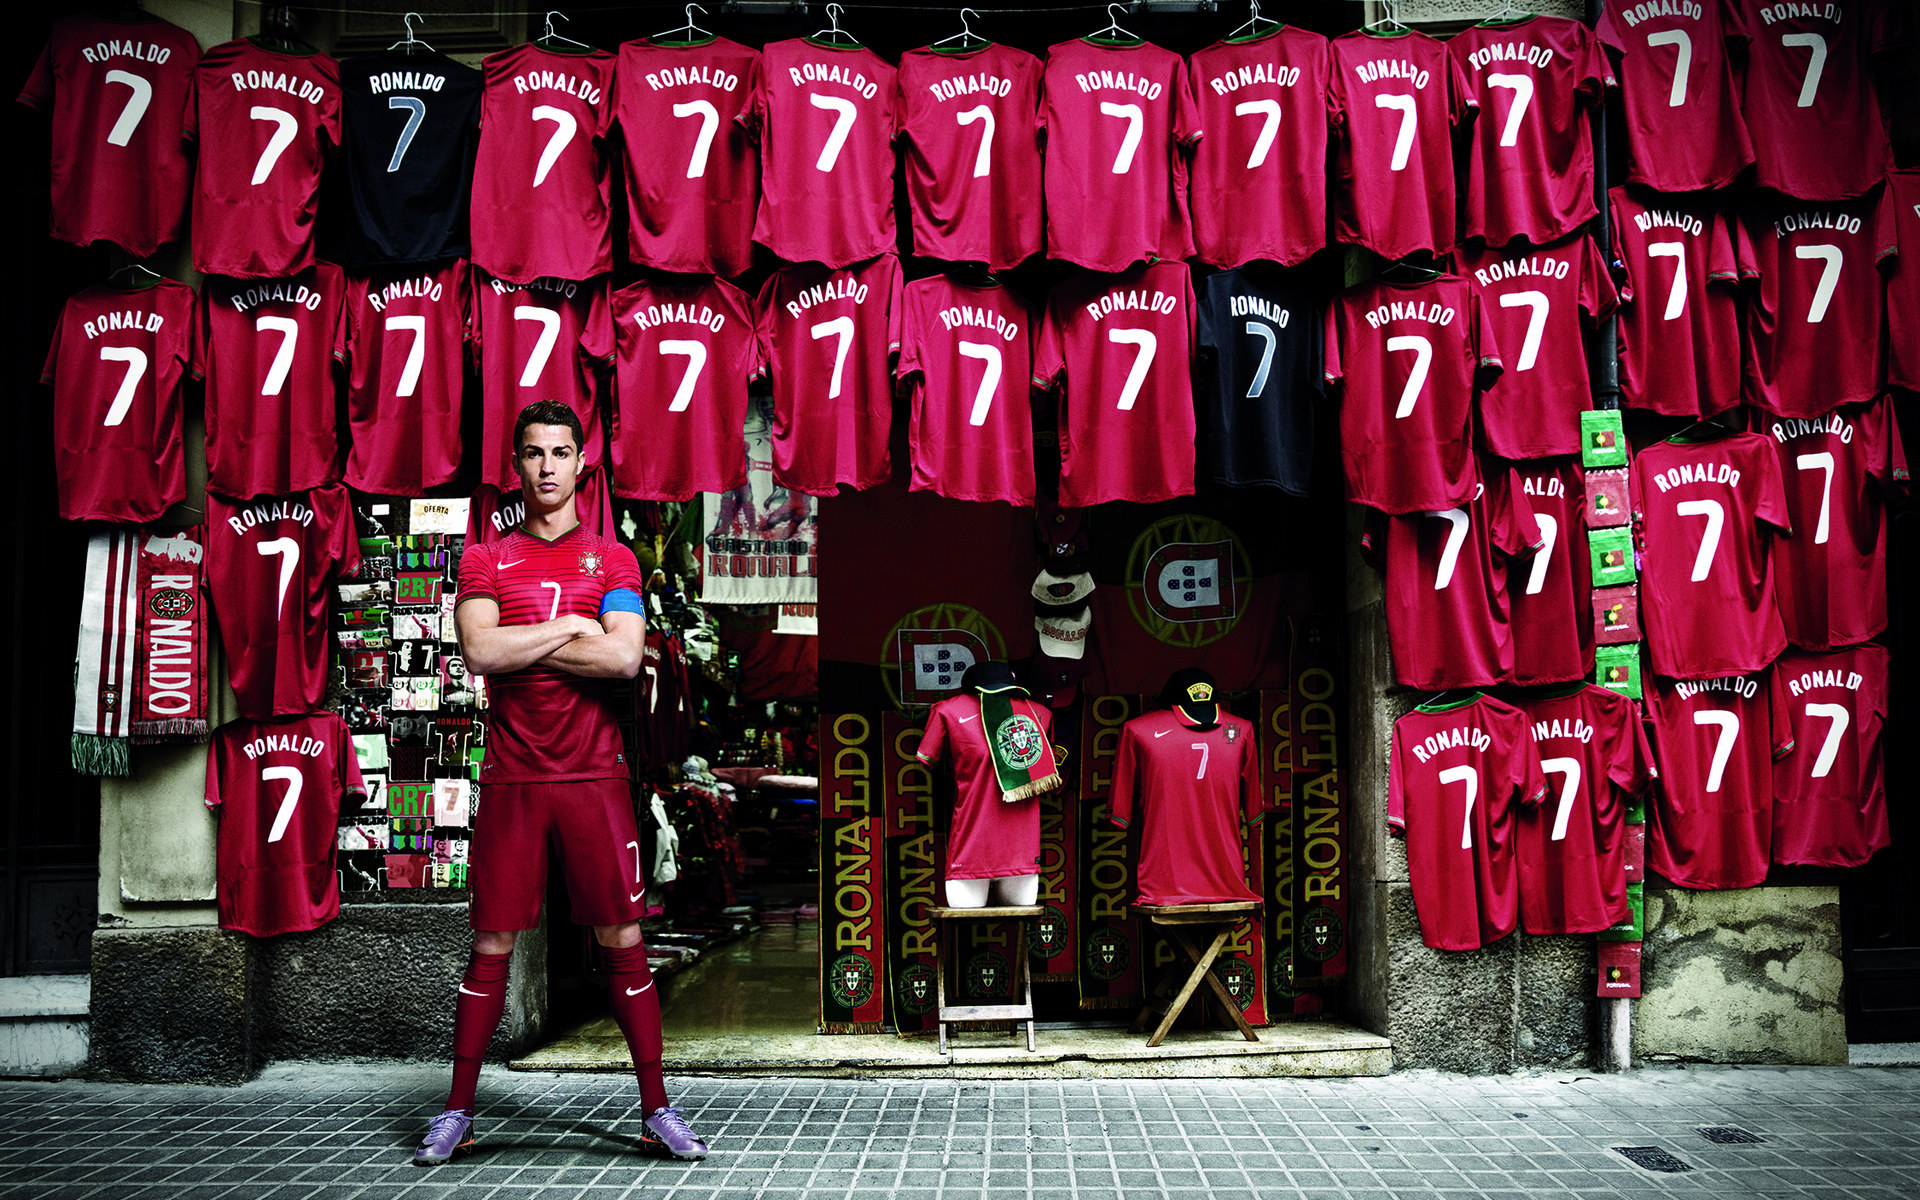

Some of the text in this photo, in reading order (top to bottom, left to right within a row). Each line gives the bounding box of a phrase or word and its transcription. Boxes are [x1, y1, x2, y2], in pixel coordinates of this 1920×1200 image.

[1623, 0, 1701, 27] RONALDO
[1760, 2, 1842, 25] RONALDO
[83, 40, 170, 64] RONALDO
[232, 70, 324, 104] RONALDO
[370, 72, 445, 94] RONALDO
[645, 66, 738, 91] RONALDO
[789, 63, 877, 100] RONALDO
[929, 73, 1011, 102] RONALDO
[1075, 70, 1162, 100] RONALDO
[1210, 63, 1300, 95] RONALDO
[1648, 29, 1691, 107] 7
[1782, 33, 1827, 107] 7
[106, 70, 152, 146] 7
[387, 97, 425, 172] 7
[673, 100, 719, 178] 7
[810, 93, 857, 172] 7
[957, 105, 995, 178] 7
[1100, 102, 1143, 174] 7
[1236, 99, 1281, 169] 7
[1375, 94, 1417, 171] 7
[1487, 73, 1533, 147] 7
[250, 106, 298, 185] 7
[532, 105, 577, 187] 7
[1775, 212, 1862, 239] RONALDO
[231, 285, 321, 312] RONALDO
[786, 278, 868, 319] RONALDO
[1087, 290, 1176, 321] RONALDO
[1475, 257, 1569, 287] RONALDO
[1648, 242, 1687, 320] 7
[1796, 244, 1843, 322] 7
[514, 306, 560, 387] 7
[633, 303, 725, 332] RONALDO
[1230, 295, 1290, 328] RONALDO
[1365, 301, 1455, 329] RONALDO
[1500, 291, 1549, 371] 7
[100, 347, 147, 426] 7
[257, 316, 298, 395] 7
[386, 316, 425, 397] 7
[659, 340, 707, 412] 7
[811, 316, 854, 399] 7
[959, 341, 1002, 426] 7
[1109, 328, 1157, 410] 7
[1246, 321, 1277, 398] 7
[1387, 336, 1432, 419] 7
[1772, 415, 1853, 443] RONALDO
[424, 505, 449, 515] OFERTA
[1654, 463, 1740, 493] RONALDO
[1797, 452, 1834, 544] 7
[228, 501, 313, 535] RONALDO
[709, 537, 808, 555] CRISTIANO
[1427, 508, 1470, 590] 7
[1677, 500, 1724, 582] 7
[257, 537, 299, 620] 7
[399, 577, 439, 598] CR7
[541, 582, 561, 620] 7
[421, 644, 434, 670] 7
[645, 666, 657, 713] 7
[243, 734, 325, 760] RONALDO
[436, 718, 471, 726] RONALDO
[1412, 727, 1491, 763] RONALDO
[1694, 710, 1739, 792] 7
[1806, 703, 1849, 777] 7
[367, 780, 380, 803] 7
[1191, 743, 1209, 779] 7
[1299, 667, 1341, 902] RONALDO
[262, 766, 303, 842] 7
[388, 785, 433, 816] CR7
[444, 786, 460, 812] 7
[833, 713, 872, 951] RONALDO
[1439, 765, 1477, 849] 7
[1540, 757, 1581, 840] 7
[627, 841, 640, 883] 7
